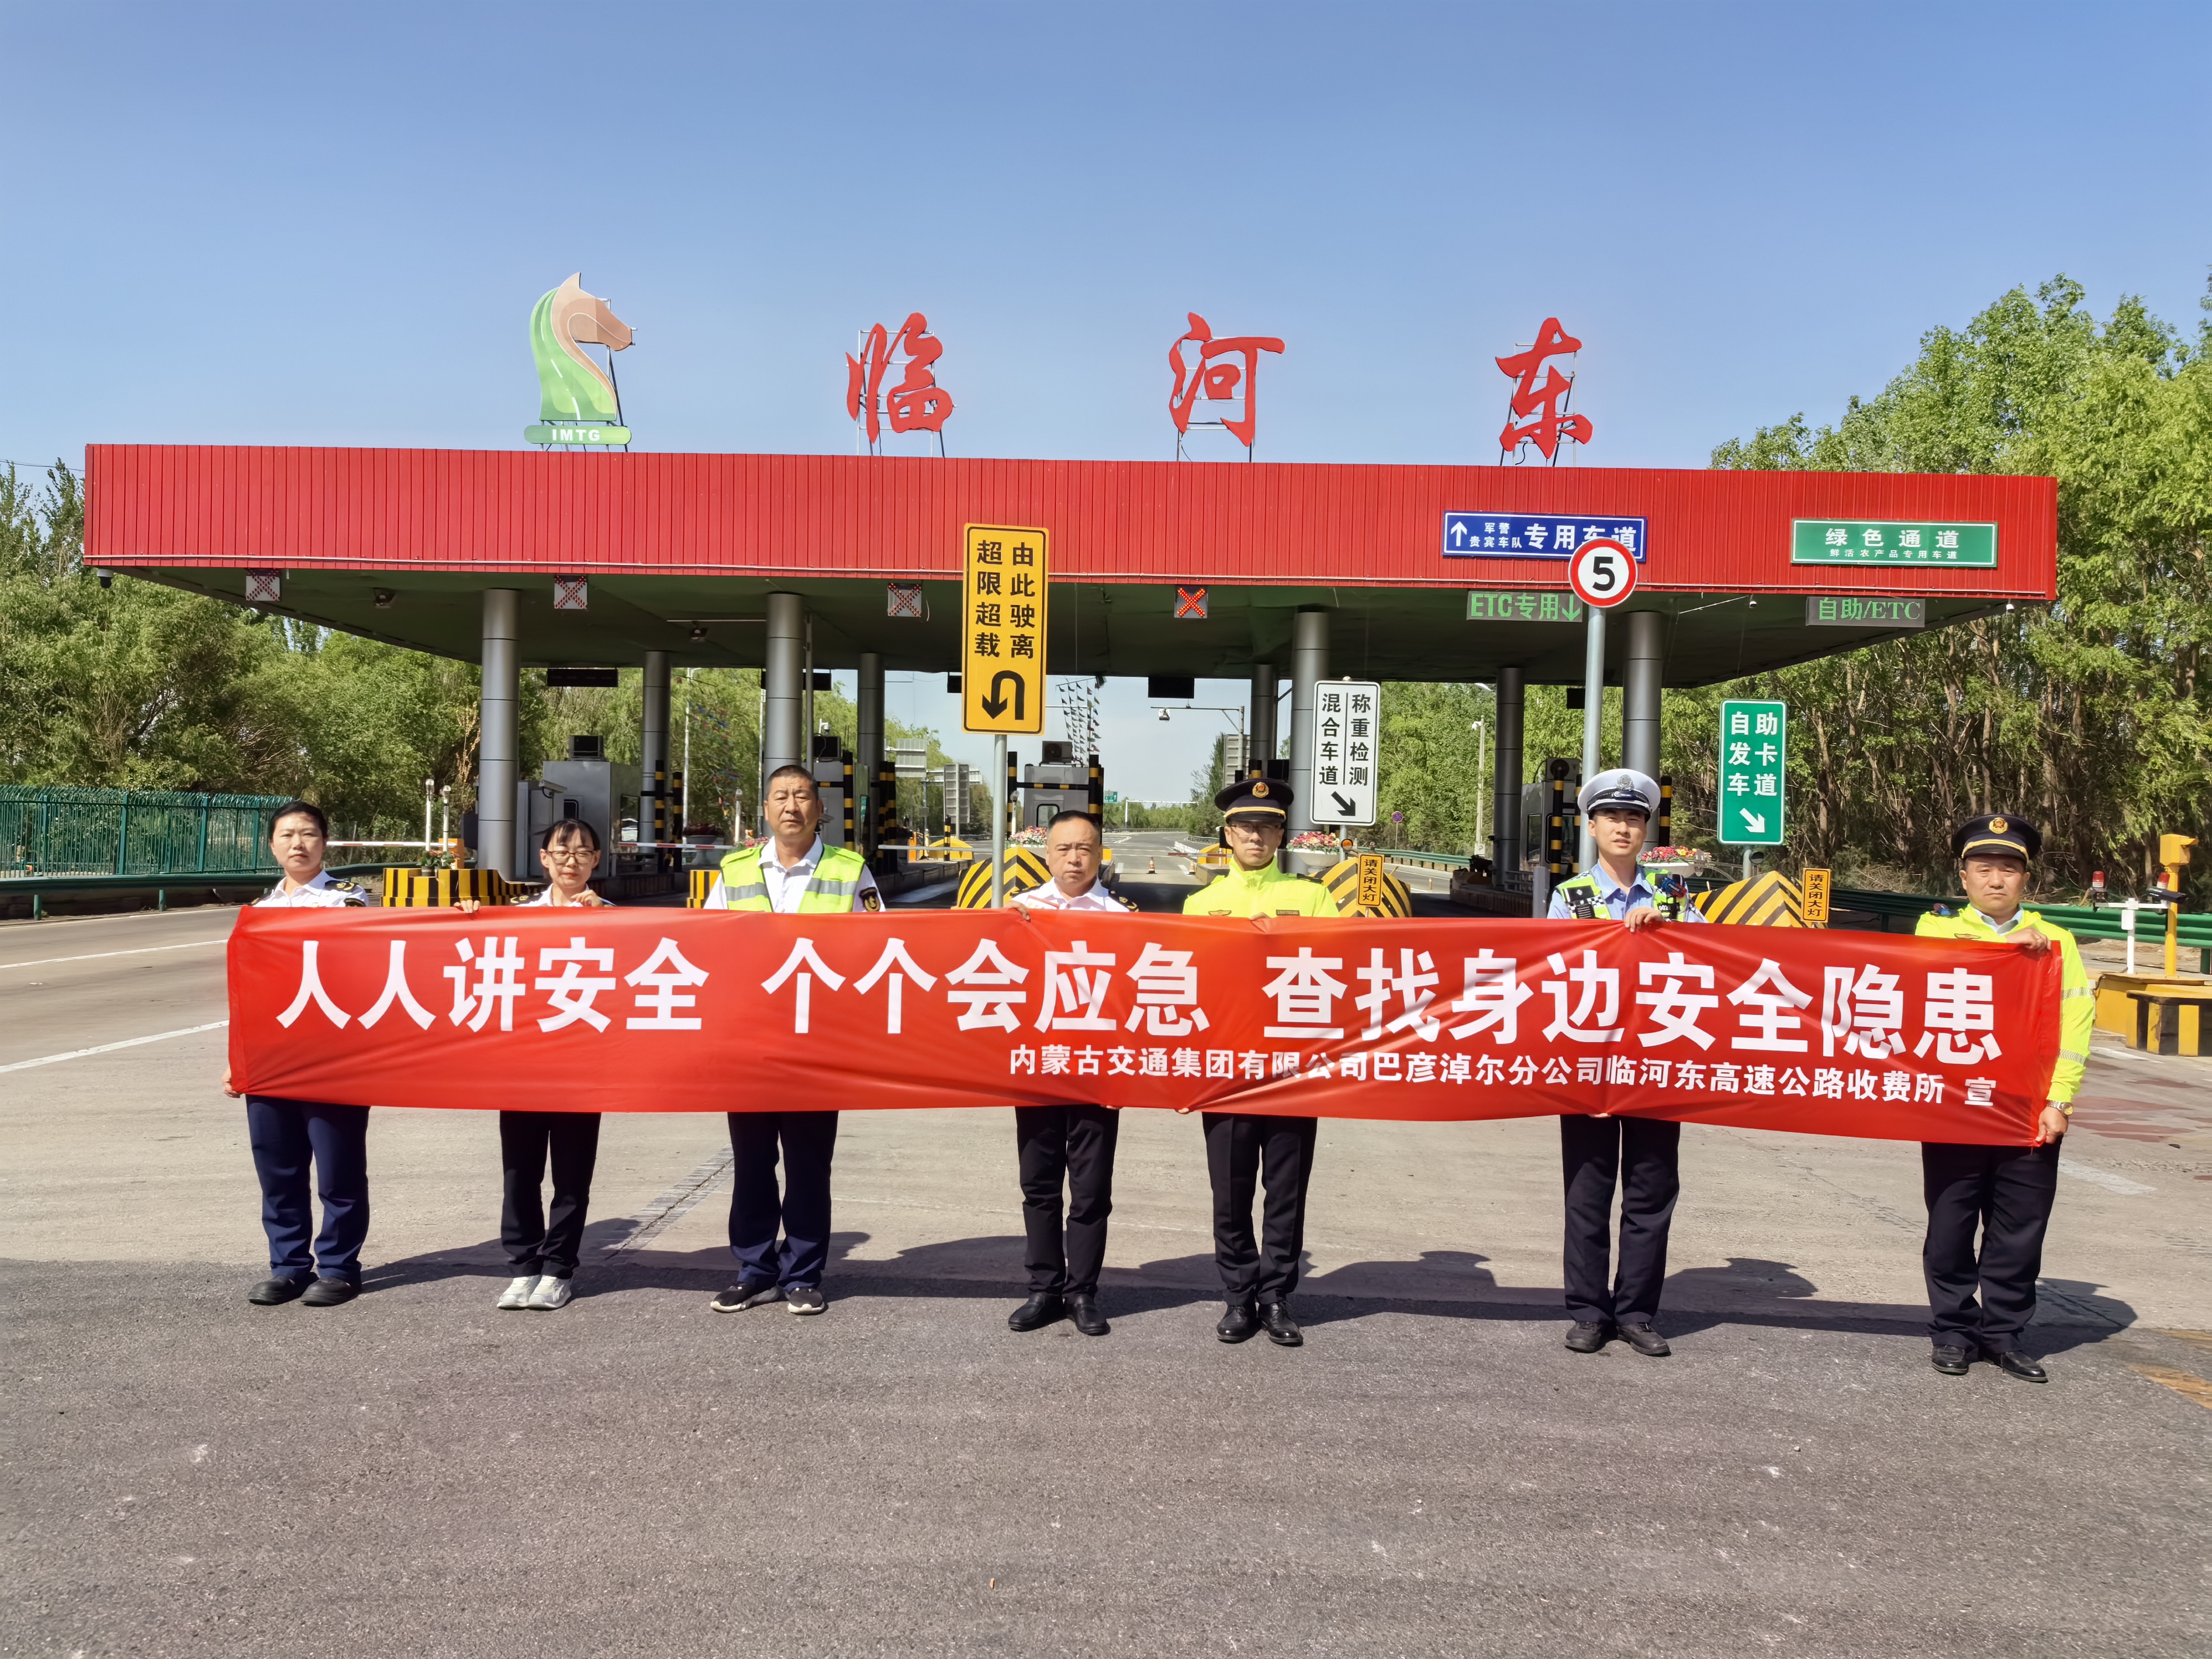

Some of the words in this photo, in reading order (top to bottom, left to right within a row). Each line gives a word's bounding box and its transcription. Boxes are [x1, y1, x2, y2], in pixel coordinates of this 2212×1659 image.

[551, 429, 601, 442] IMTG
[1484, 522, 1510, 535] 军警
[1825, 528, 1960, 548] 绿色通道
[1469, 536, 1522, 549] 贵宾车队
[1830, 548, 1958, 559] 鲜活农产品专用车道
[1592, 556, 1615, 591] 5
[974, 540, 1003, 658] 超限超载
[1010, 542, 1036, 659] 由此驶离
[1471, 593, 1560, 620] ETC专用
[1819, 597, 1920, 620] 自助/ETC
[1731, 711, 1778, 736] 自助
[1319, 693, 1341, 785] 混合车道
[1348, 693, 1371, 786] 称重检测
[1728, 741, 1778, 766] 发卡
[1727, 772, 1778, 797] 车道
[1363, 859, 1378, 901] 请关闭大灯
[1808, 874, 1824, 917] 请关闭大灯
[276, 936, 710, 1033] 人人讲安全
[761, 937, 1210, 1036] 个个会应急
[1262, 947, 2002, 1065] 查找身边安全隐患
[1010, 1044, 1945, 1104] 内蒙古交通集团有限公司巴彦淖尔分公司临河东高速公路收费所
[1964, 1077, 1997, 1107] 宣
